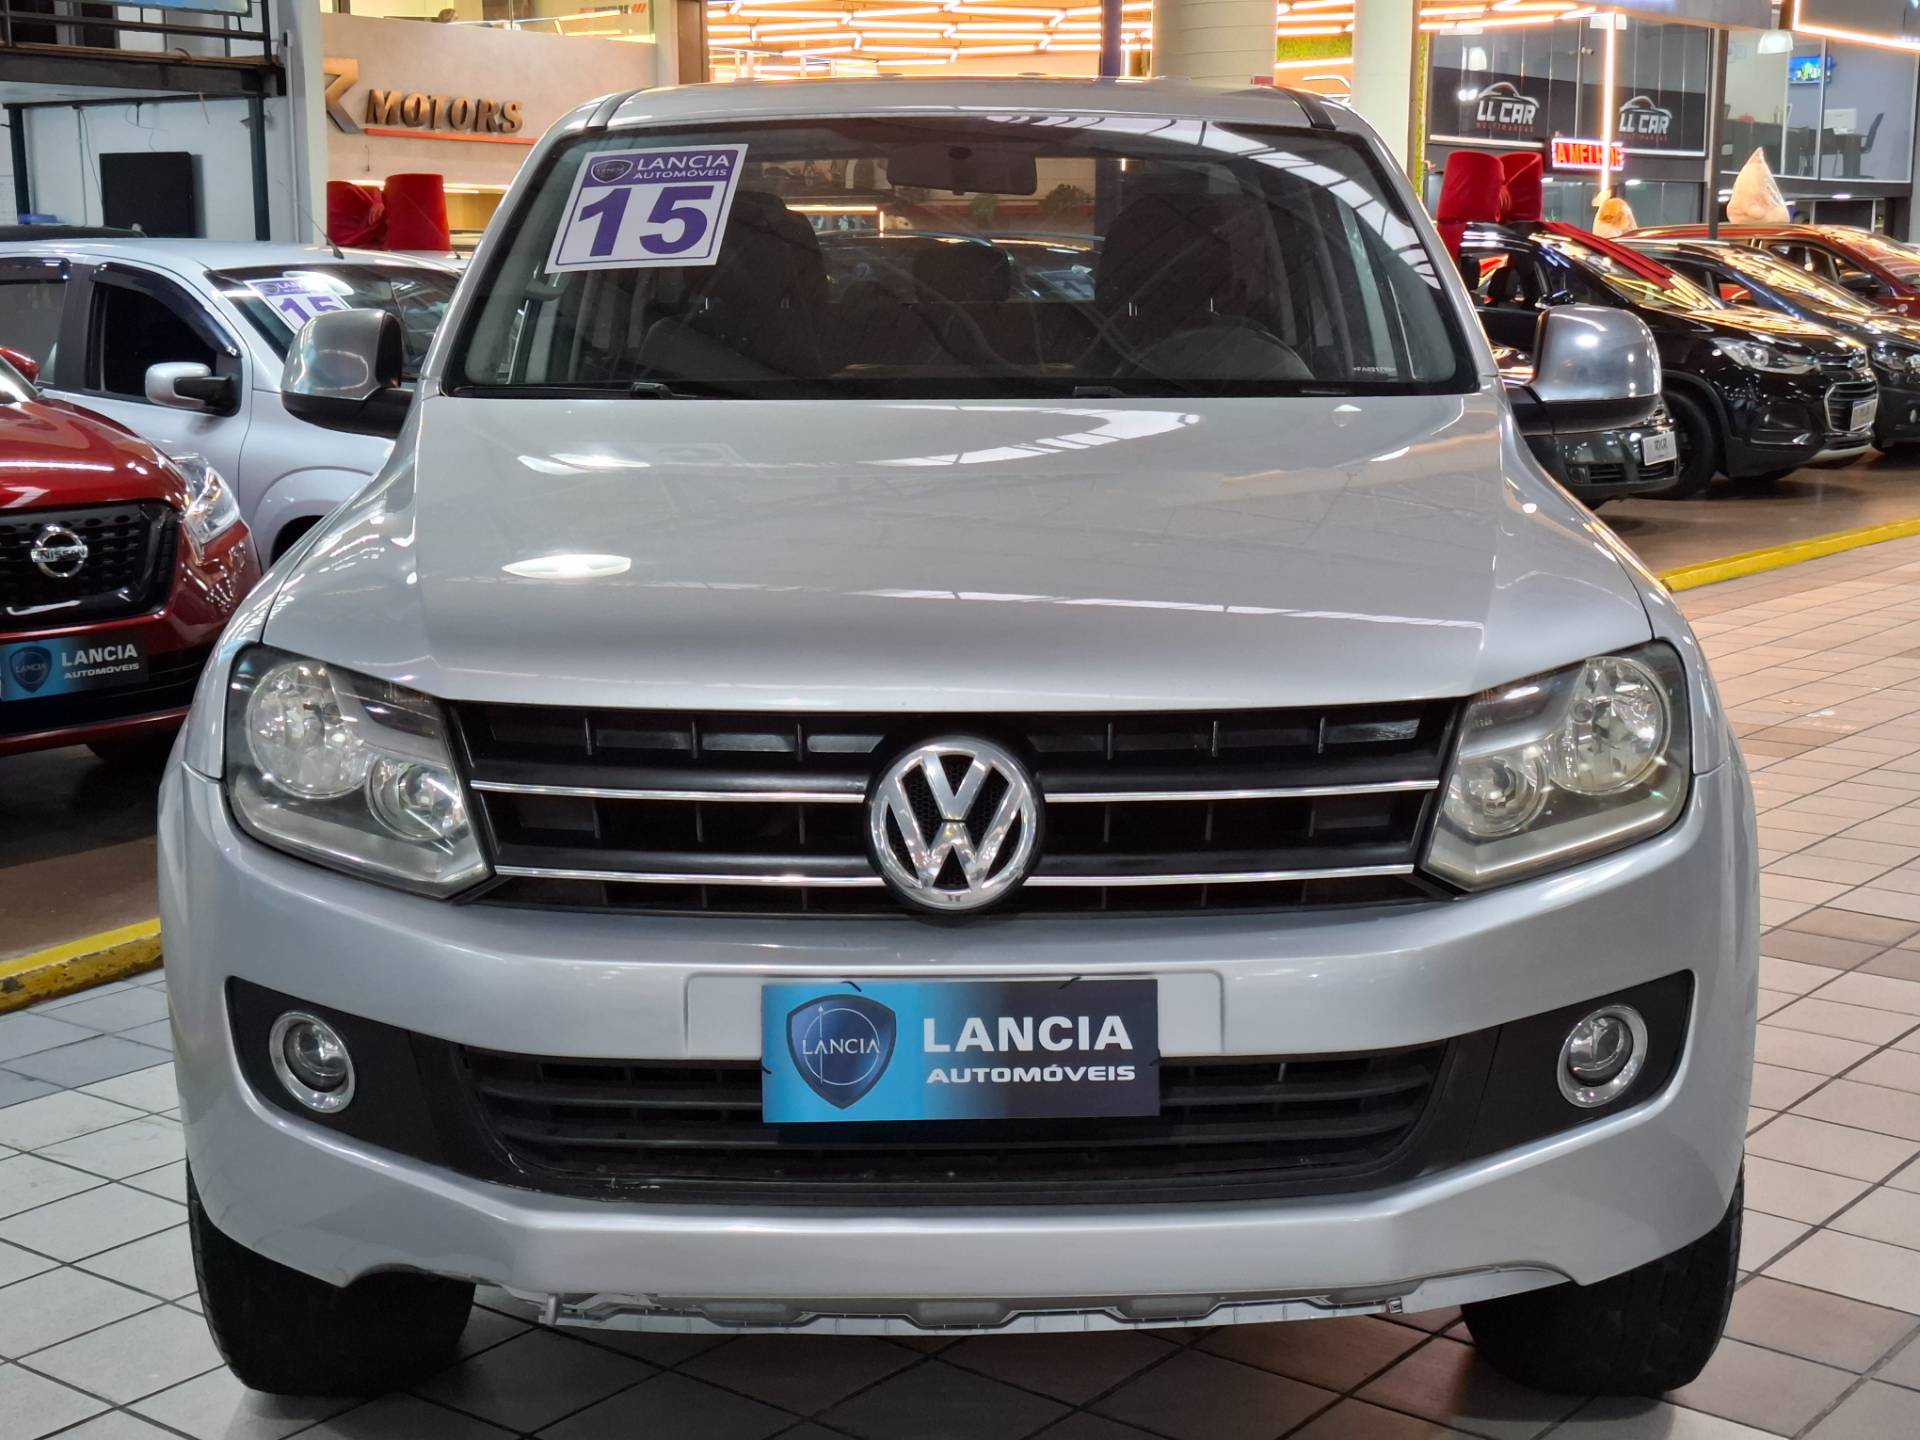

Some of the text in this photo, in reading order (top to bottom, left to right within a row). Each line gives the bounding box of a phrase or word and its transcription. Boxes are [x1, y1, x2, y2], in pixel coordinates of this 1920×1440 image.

[365, 88, 523, 133] MOTORS
[1476, 100, 1536, 125] LL CAR
[1618, 113, 1670, 135] LL CAR
[637, 154, 730, 172] LANCIA
[578, 185, 715, 257] 15
[61, 643, 138, 667] LANCIA
[802, 1037, 880, 1055] LANCIA
[923, 1015, 1133, 1053] LANCIA
[926, 1063, 1136, 1084] AUTOMÓVEIS
